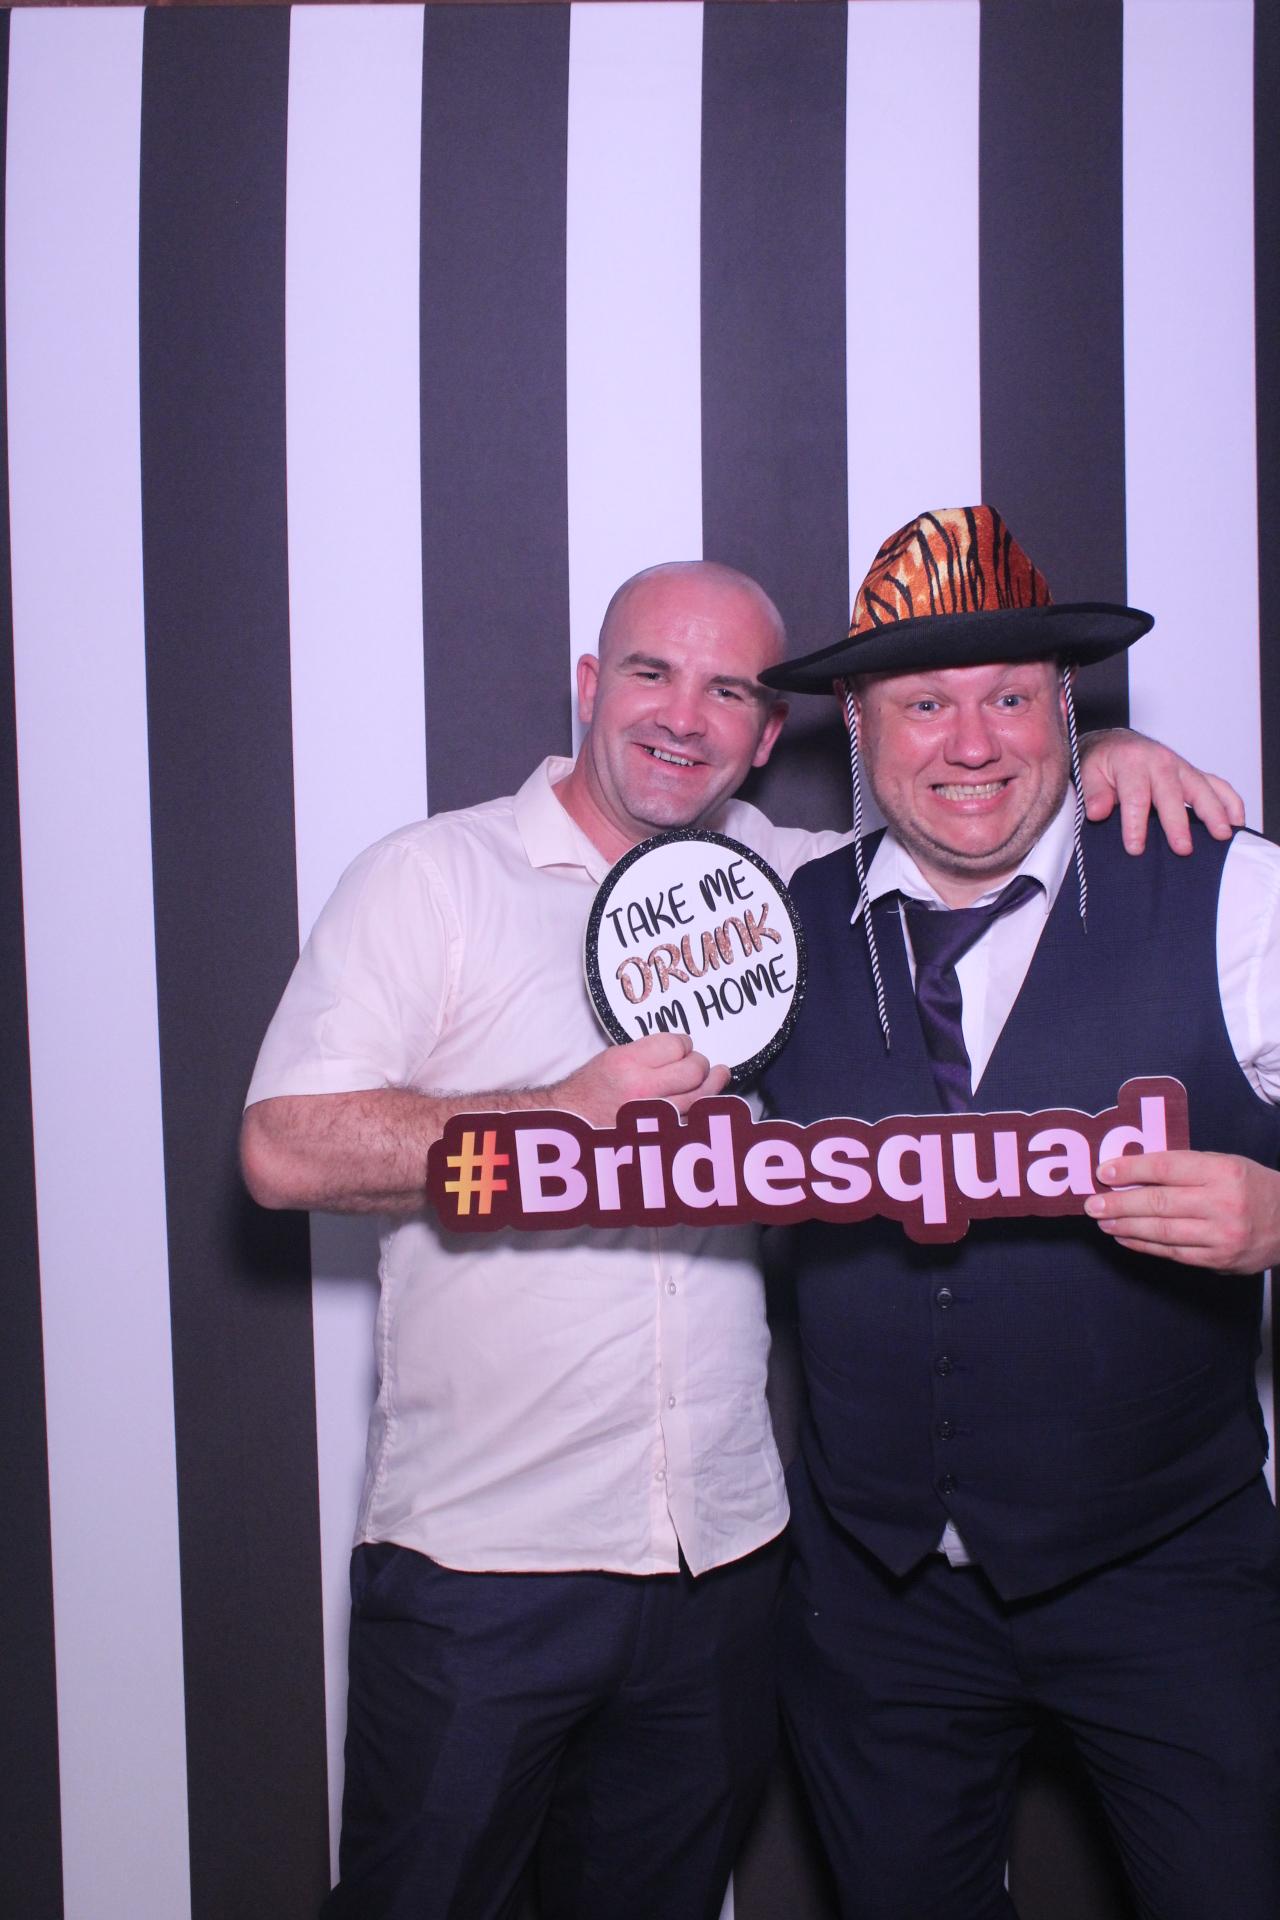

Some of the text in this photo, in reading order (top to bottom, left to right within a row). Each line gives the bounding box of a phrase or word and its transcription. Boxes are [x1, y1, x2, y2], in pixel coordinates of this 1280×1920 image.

[606, 859, 754, 948] TAKE ME
[616, 902, 782, 1004] DRUNK
[634, 954, 794, 1037] I'M HOME
[444, 1096, 1167, 1224] #Bridesquad
